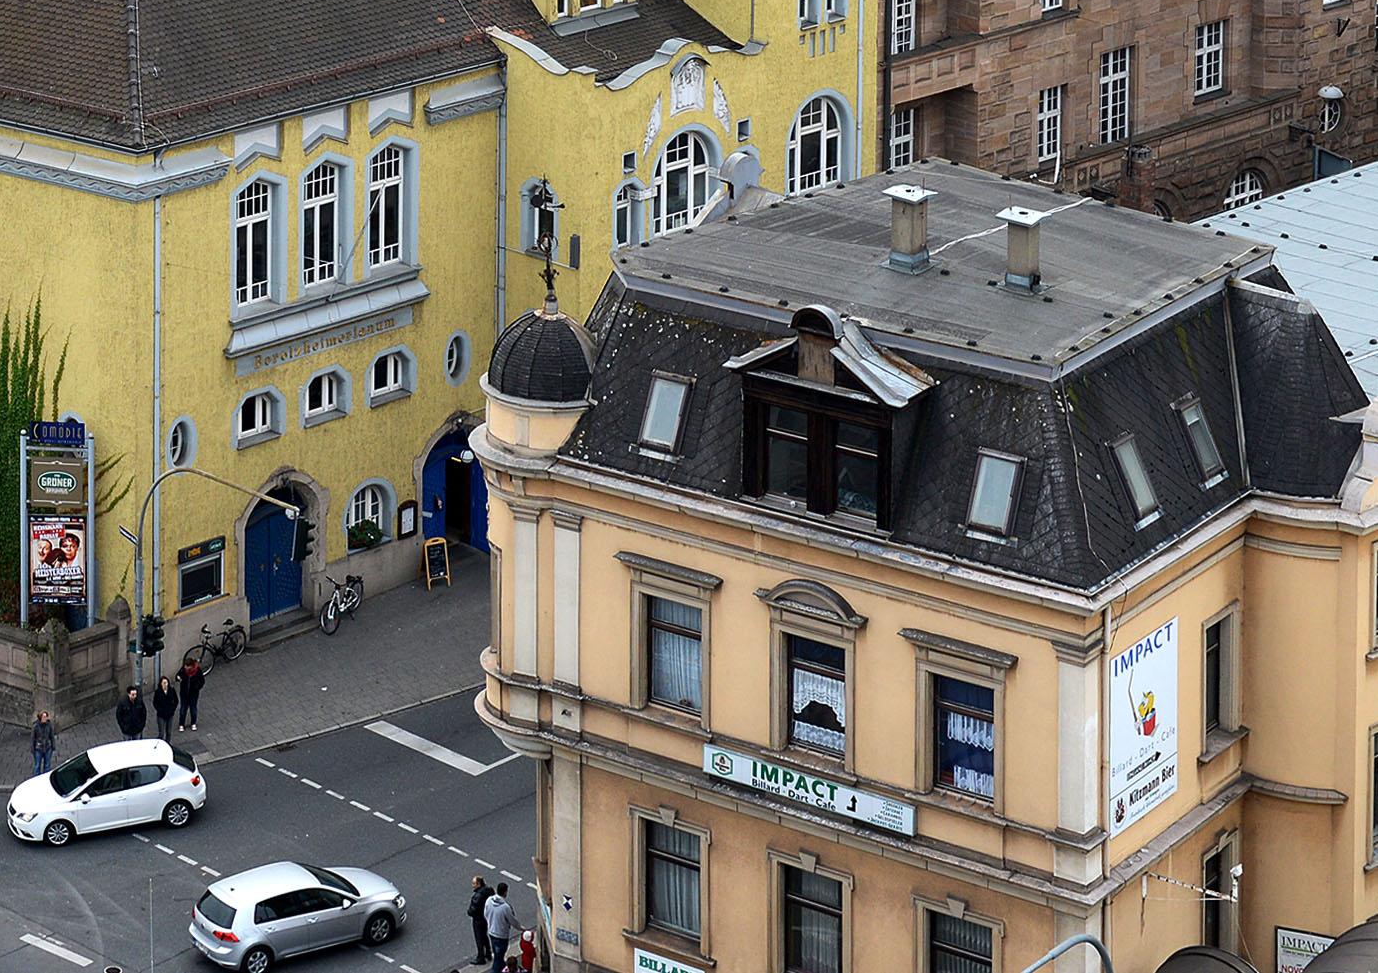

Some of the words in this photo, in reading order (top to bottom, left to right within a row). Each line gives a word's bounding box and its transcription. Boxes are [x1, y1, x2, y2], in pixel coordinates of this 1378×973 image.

[1113, 622, 1174, 678] IMPACT
[751, 778, 781, 795] Billard
[788, 788, 809, 804] Dart
[815, 797, 837, 812] Cafe
[752, 761, 838, 801] IMPACT
[1129, 776, 1160, 807] Kitzmann
[1161, 764, 1175, 783] Bier
[1282, 936, 1329, 953] IMPACT
[639, 955, 689, 973] BILLA
